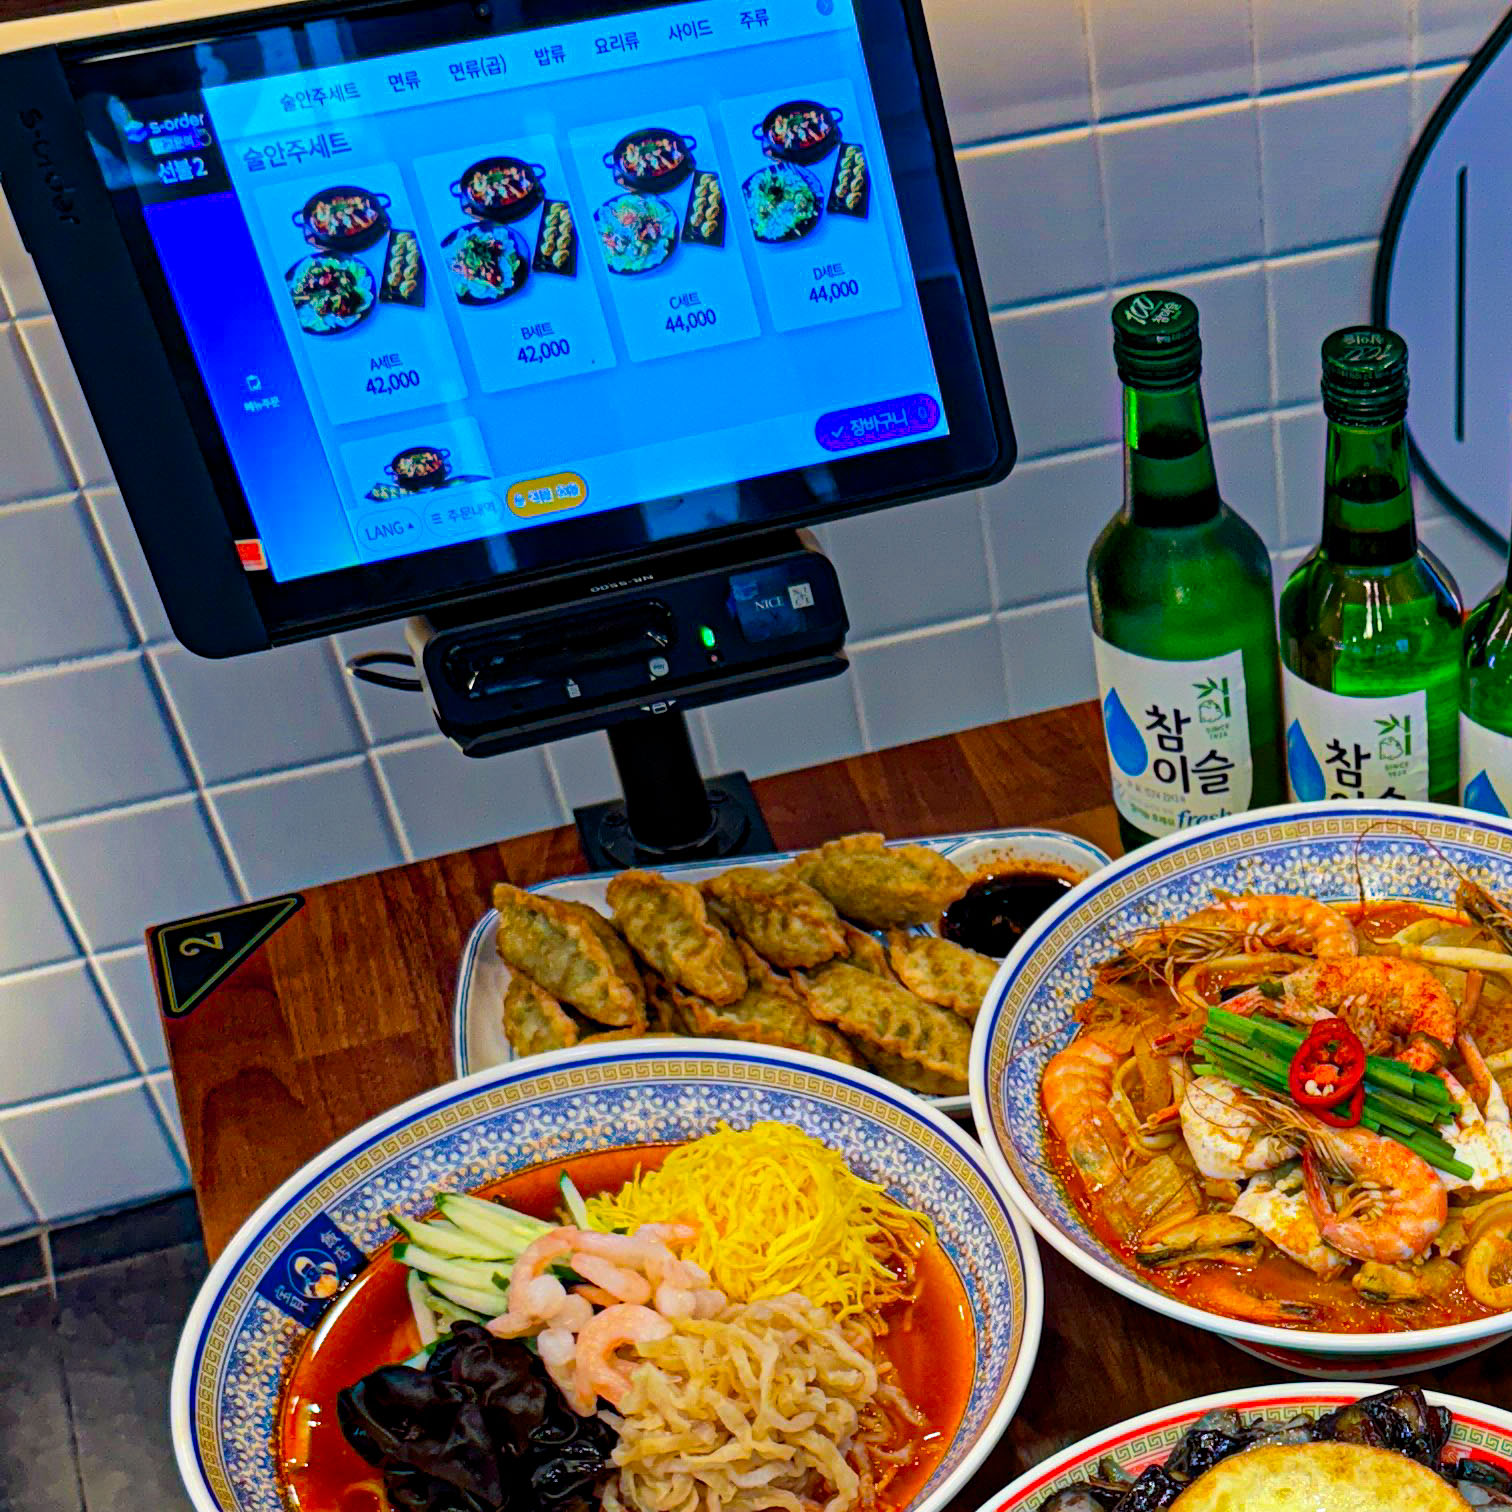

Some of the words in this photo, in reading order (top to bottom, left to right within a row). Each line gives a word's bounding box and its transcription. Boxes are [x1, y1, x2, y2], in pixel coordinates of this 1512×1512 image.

[388, 70, 421, 93] 면류
[533, 44, 567, 67] 밥류
[594, 31, 641, 55] 요리류
[668, 18, 713, 42] 사이드
[740, 8, 770, 31] 주류
[149, 111, 205, 135] s-order
[243, 132, 353, 173] 술안주세트
[812, 263, 846, 281] D세트
[669, 291, 702, 310] C세트
[808, 279, 860, 304] 44,000
[520, 321, 556, 341] B세트
[664, 308, 717, 334] 44,000
[369, 352, 404, 372] A세트
[517, 338, 571, 365] 42,000
[365, 369, 421, 397] 42,000
[850, 407, 909, 438] 장바구니
[365, 521, 405, 541] LANG
[1145, 704, 1192, 754] 참
[1152, 748, 1236, 796] 이슬
[1325, 737, 1372, 789] 참
[179, 931, 224, 957] 2
